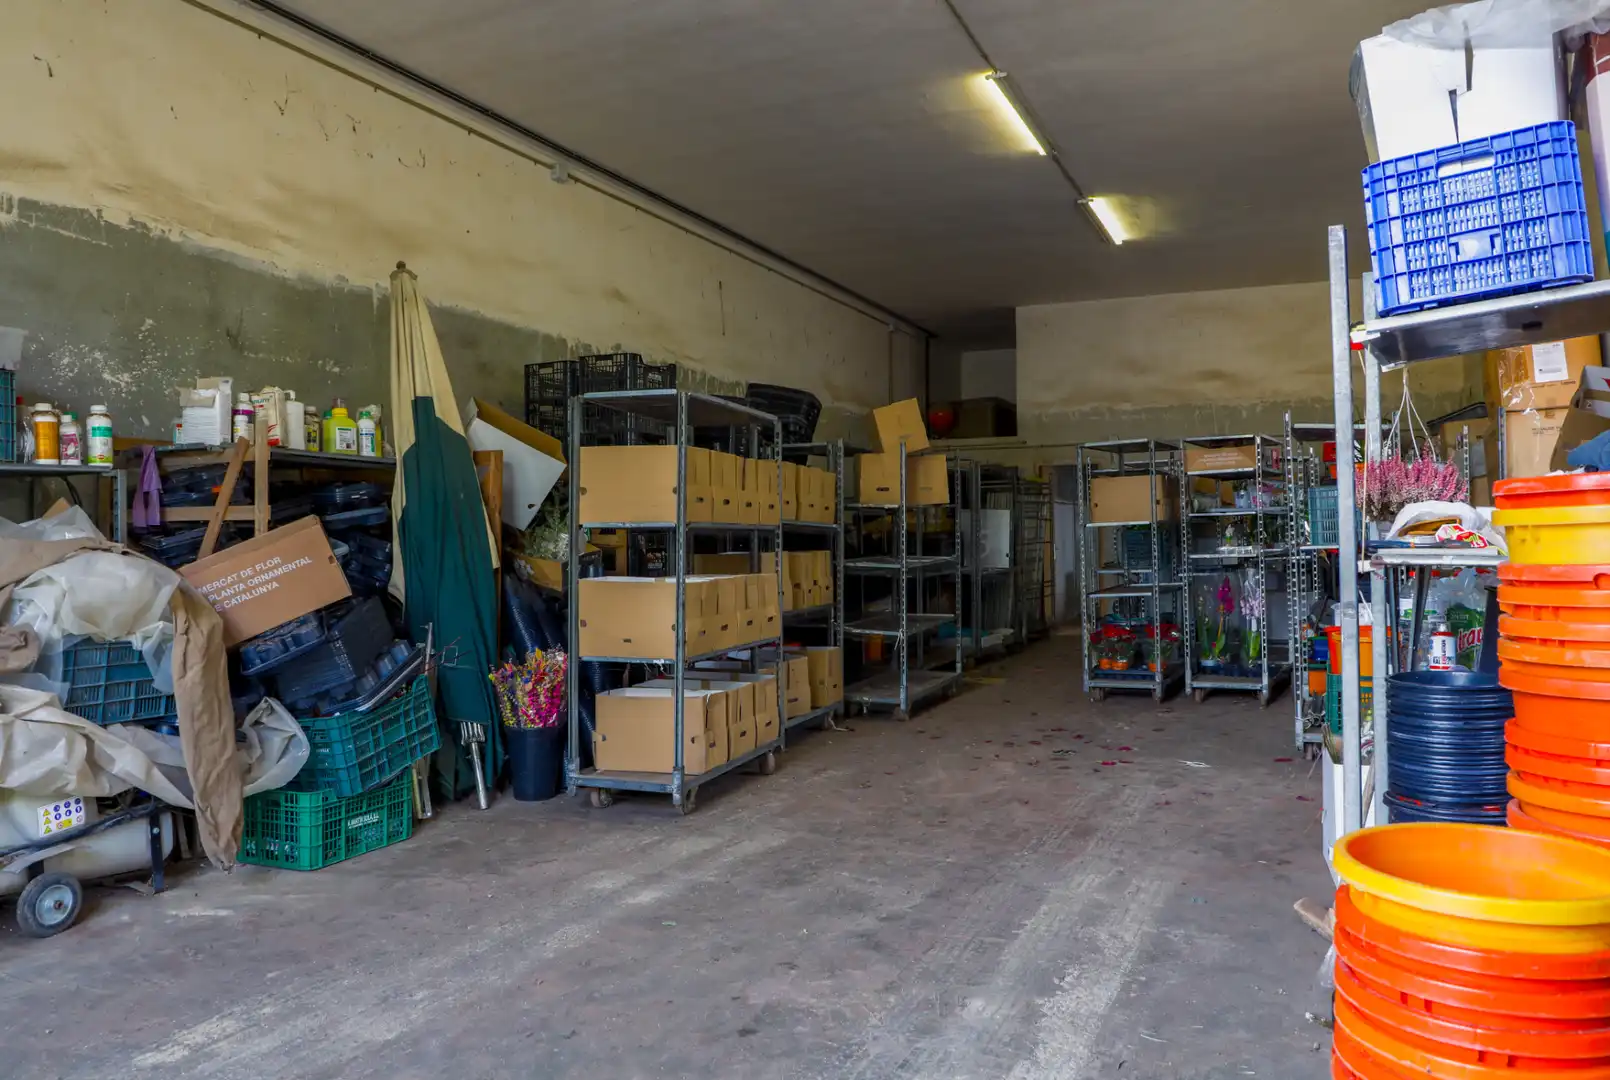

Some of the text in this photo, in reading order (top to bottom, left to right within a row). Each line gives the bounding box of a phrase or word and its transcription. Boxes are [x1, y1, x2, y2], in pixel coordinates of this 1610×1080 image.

[198, 556, 282, 594] MERCAT DE FLOR
[208, 556, 313, 602] PLANTA ORNAMENTAL
[223, 581, 280, 609] CATALUNYA
